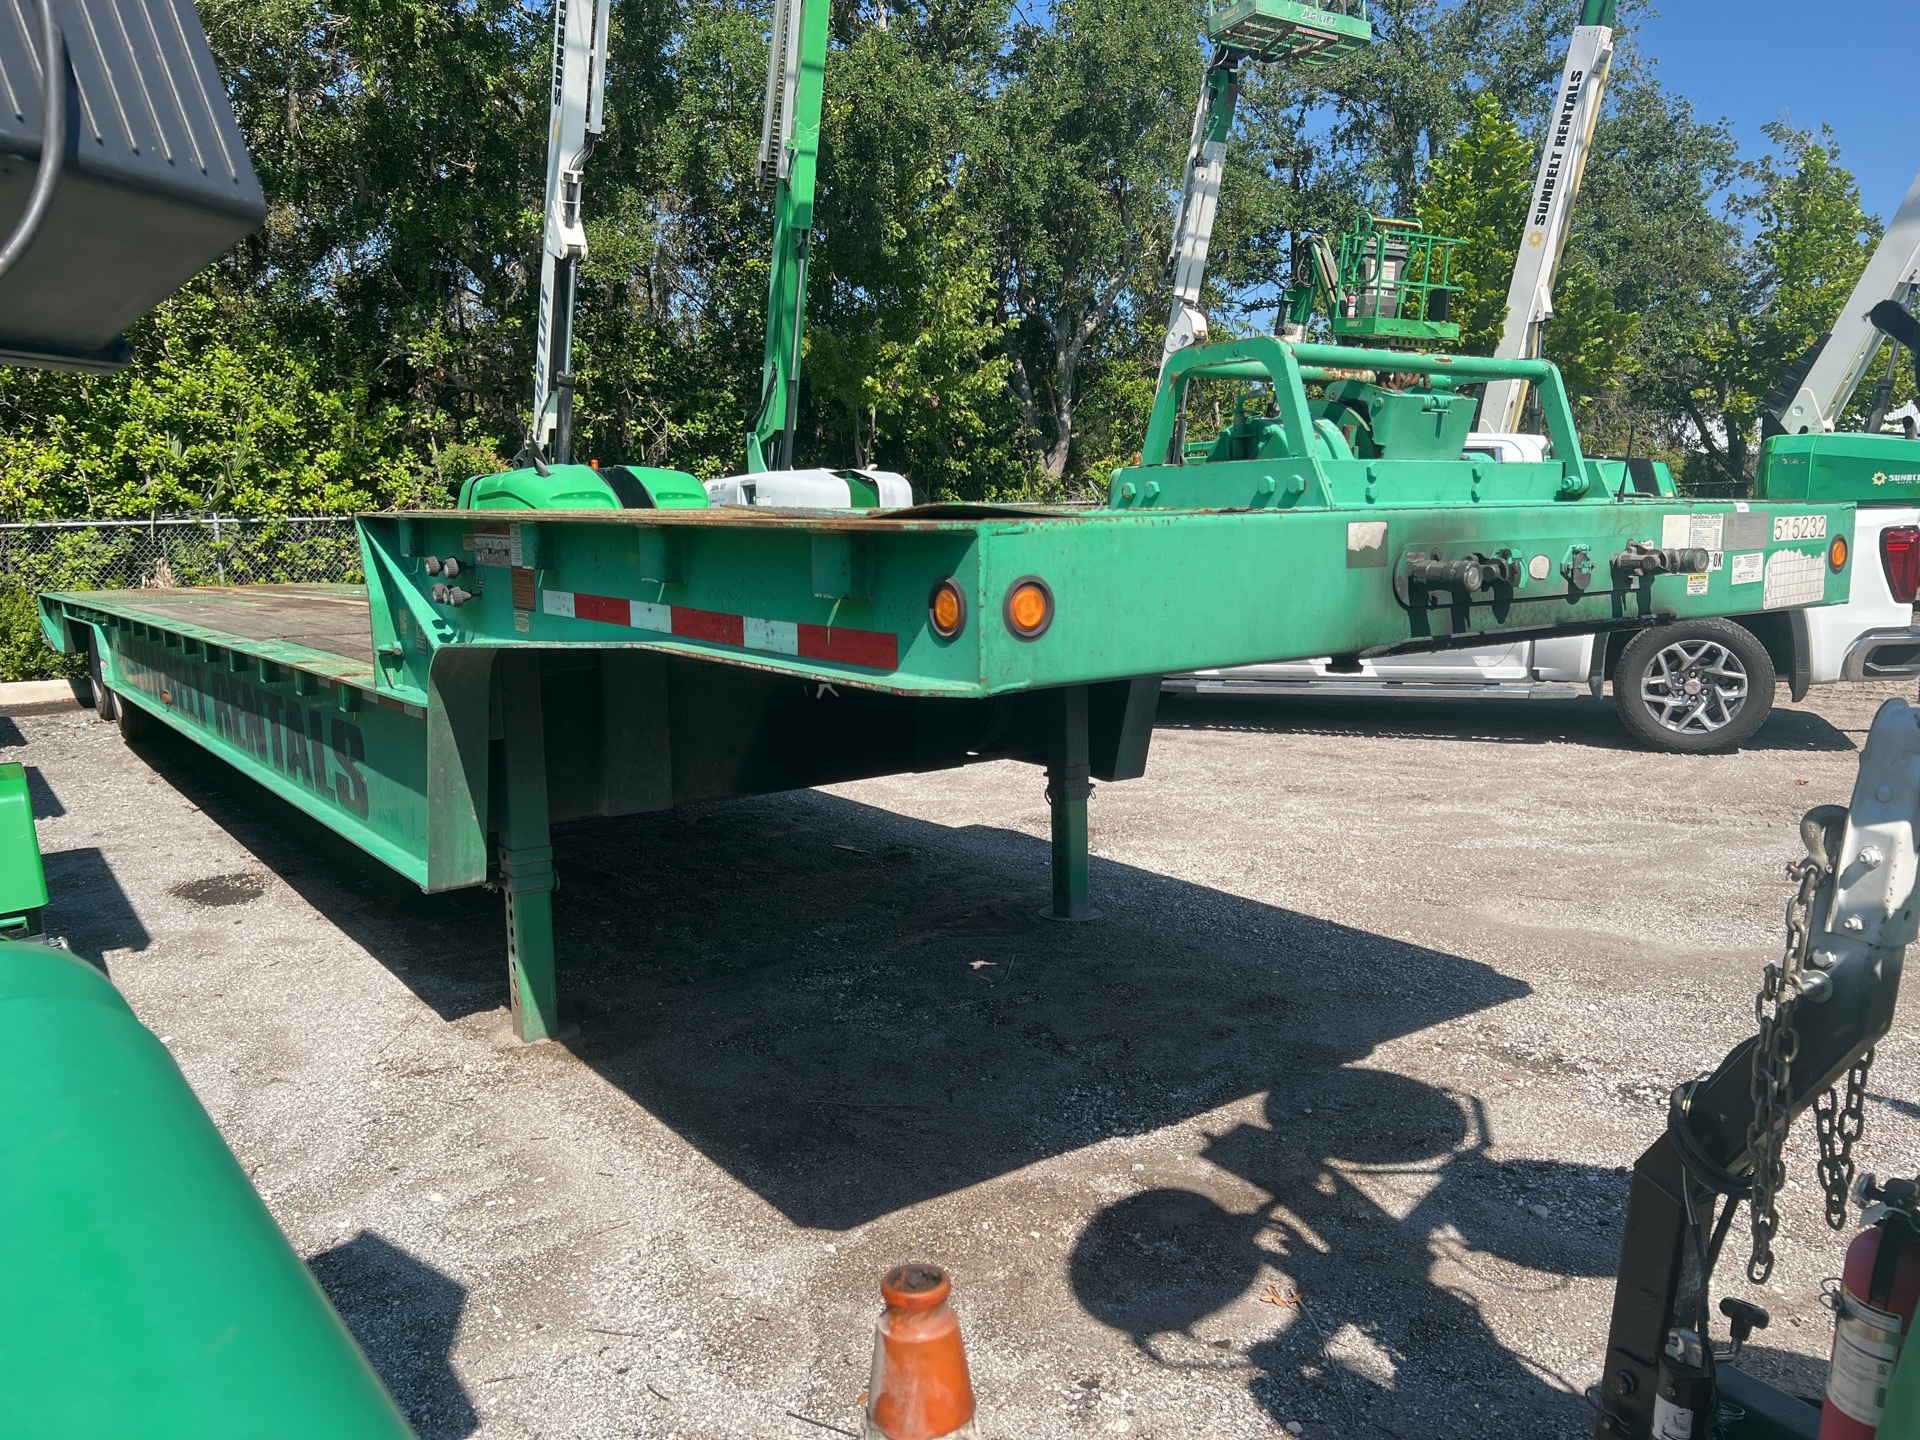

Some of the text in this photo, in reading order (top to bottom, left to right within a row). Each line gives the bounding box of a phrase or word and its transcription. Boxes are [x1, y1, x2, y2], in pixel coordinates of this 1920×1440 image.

[1301, 10, 1338, 26] JLG LIFT
[1534, 69, 1584, 226] SUNBELT RENTALS
[538, 281, 549, 353] LIFT
[1774, 516, 1826, 540] 515232
[1713, 552, 1723, 568] OK
[211, 669, 370, 822] RENTALS
